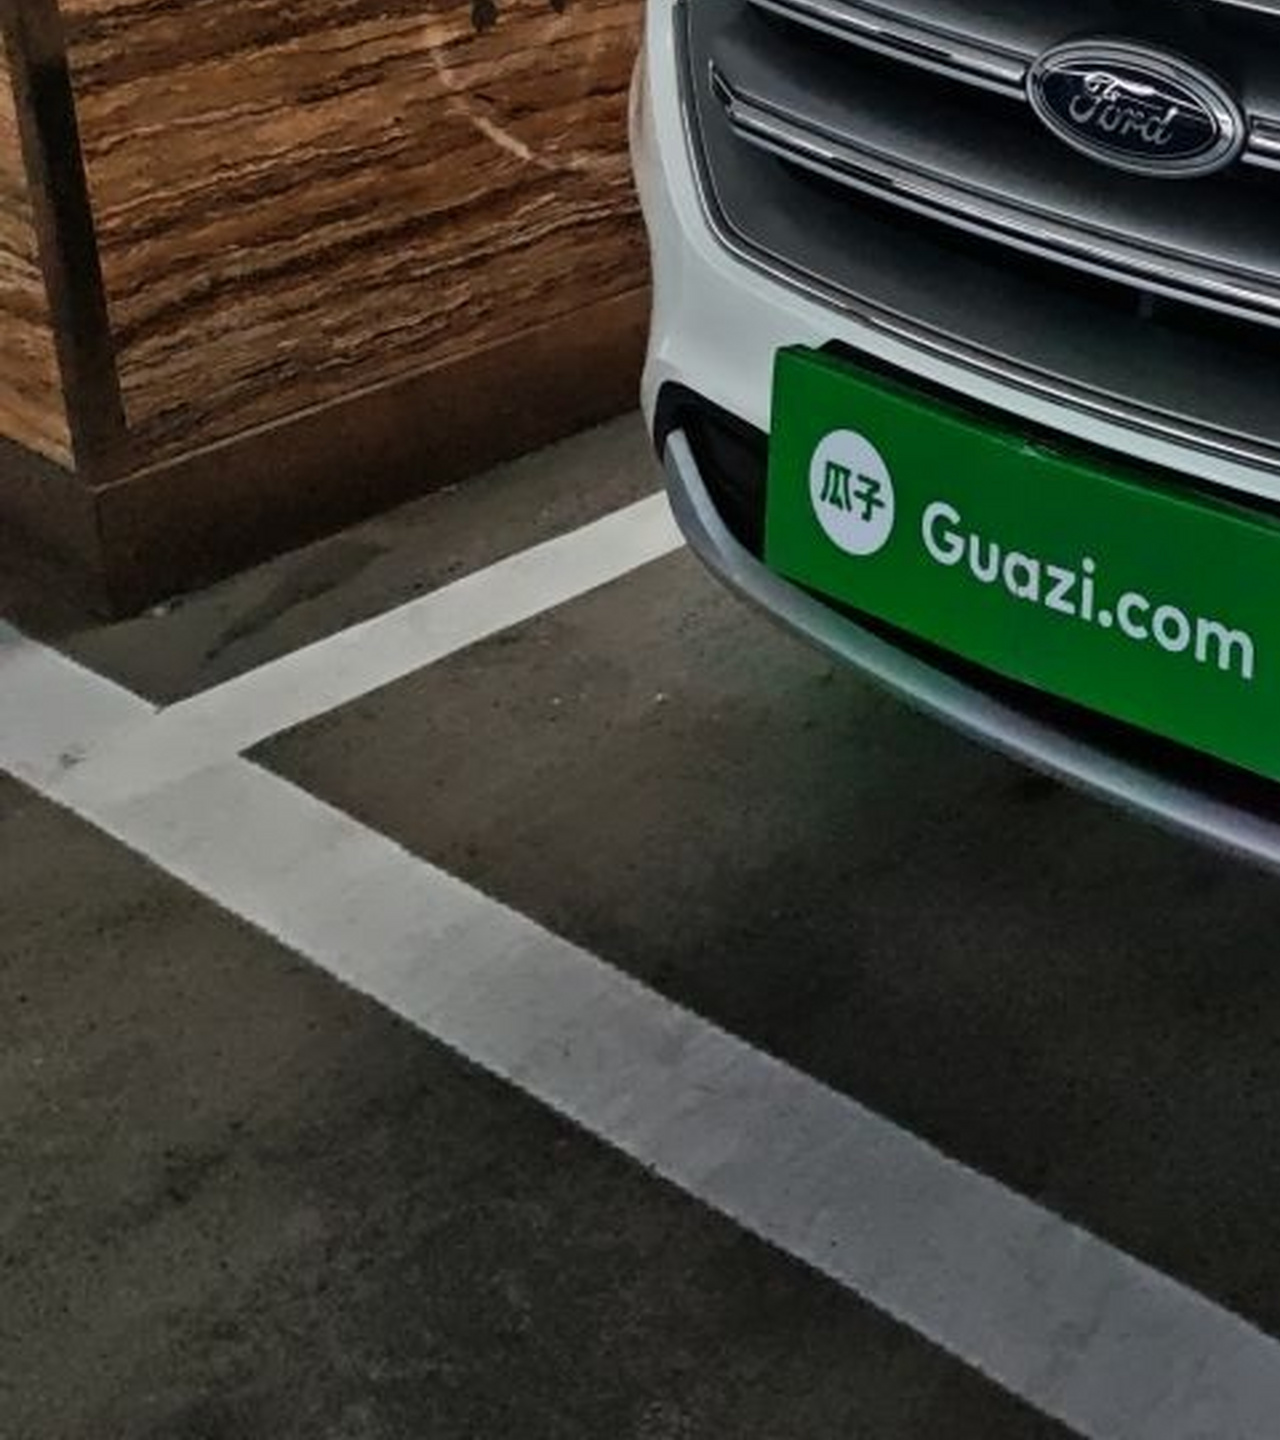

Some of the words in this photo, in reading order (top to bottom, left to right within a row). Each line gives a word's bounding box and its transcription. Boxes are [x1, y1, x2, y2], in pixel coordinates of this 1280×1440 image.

[1069, 71, 1180, 145] Ford
[820, 461, 886, 522] 瓜子
[921, 500, 1255, 680] Guazi.com
